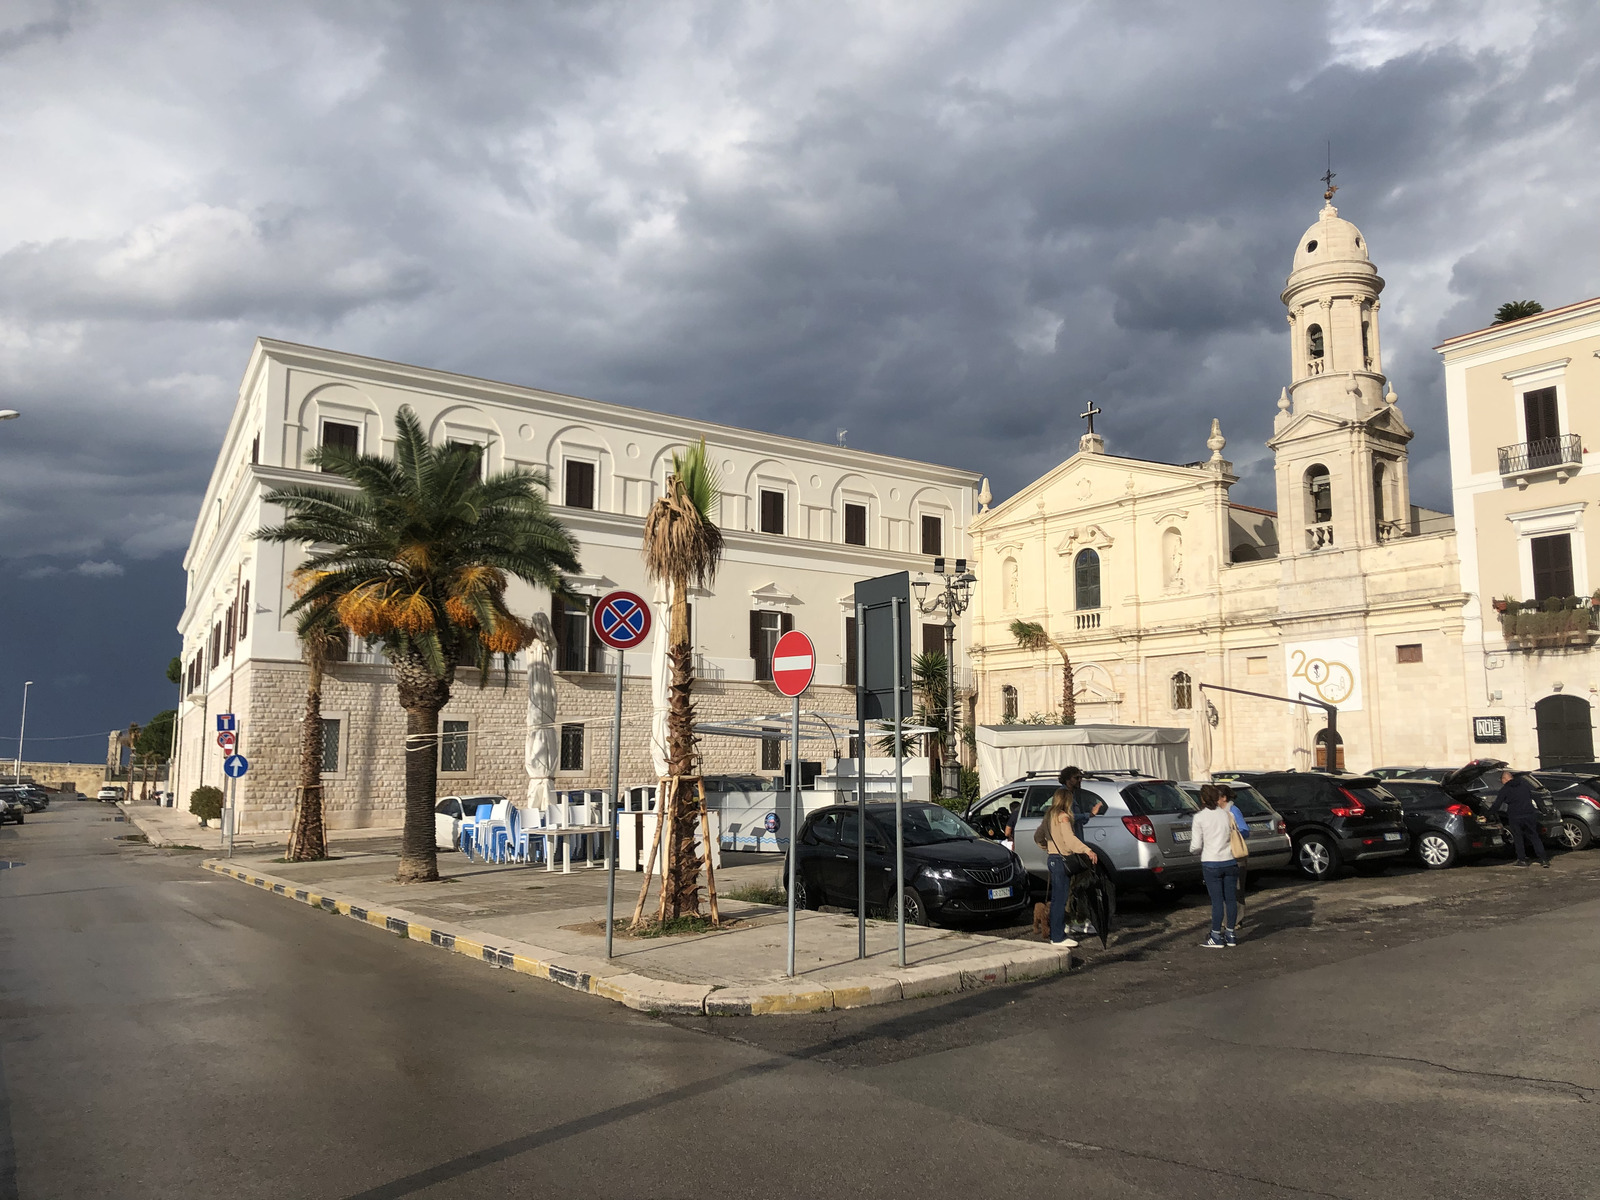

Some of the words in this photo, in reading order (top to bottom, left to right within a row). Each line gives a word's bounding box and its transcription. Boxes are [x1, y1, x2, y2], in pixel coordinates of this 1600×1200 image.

[1291, 649, 1354, 704] 200
[1475, 719, 1494, 737] NO
[1492, 718, 1502, 737] NAME
